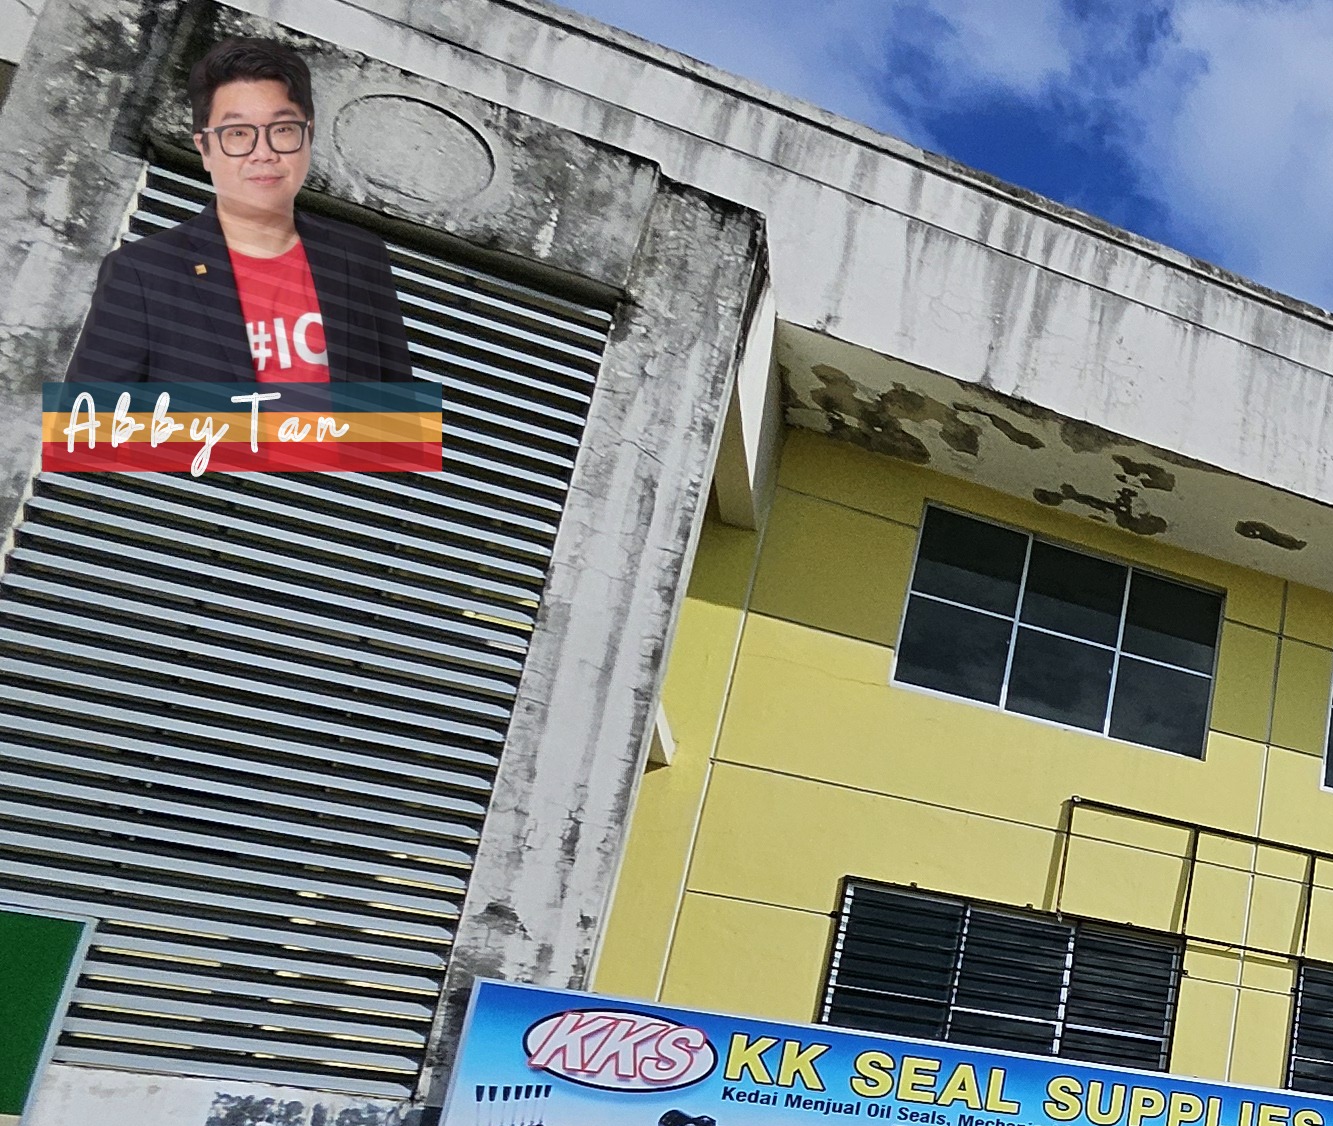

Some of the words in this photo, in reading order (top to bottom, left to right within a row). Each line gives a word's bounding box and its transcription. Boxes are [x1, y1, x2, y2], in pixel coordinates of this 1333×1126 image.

[526, 1009, 707, 1084] KKS
[724, 1033, 832, 1094] KK
[850, 1051, 1020, 1115] SEAL
[721, 1086, 778, 1107] Kedai
[784, 1094, 861, 1116] Menjual
[866, 1102, 891, 1120] Oil
